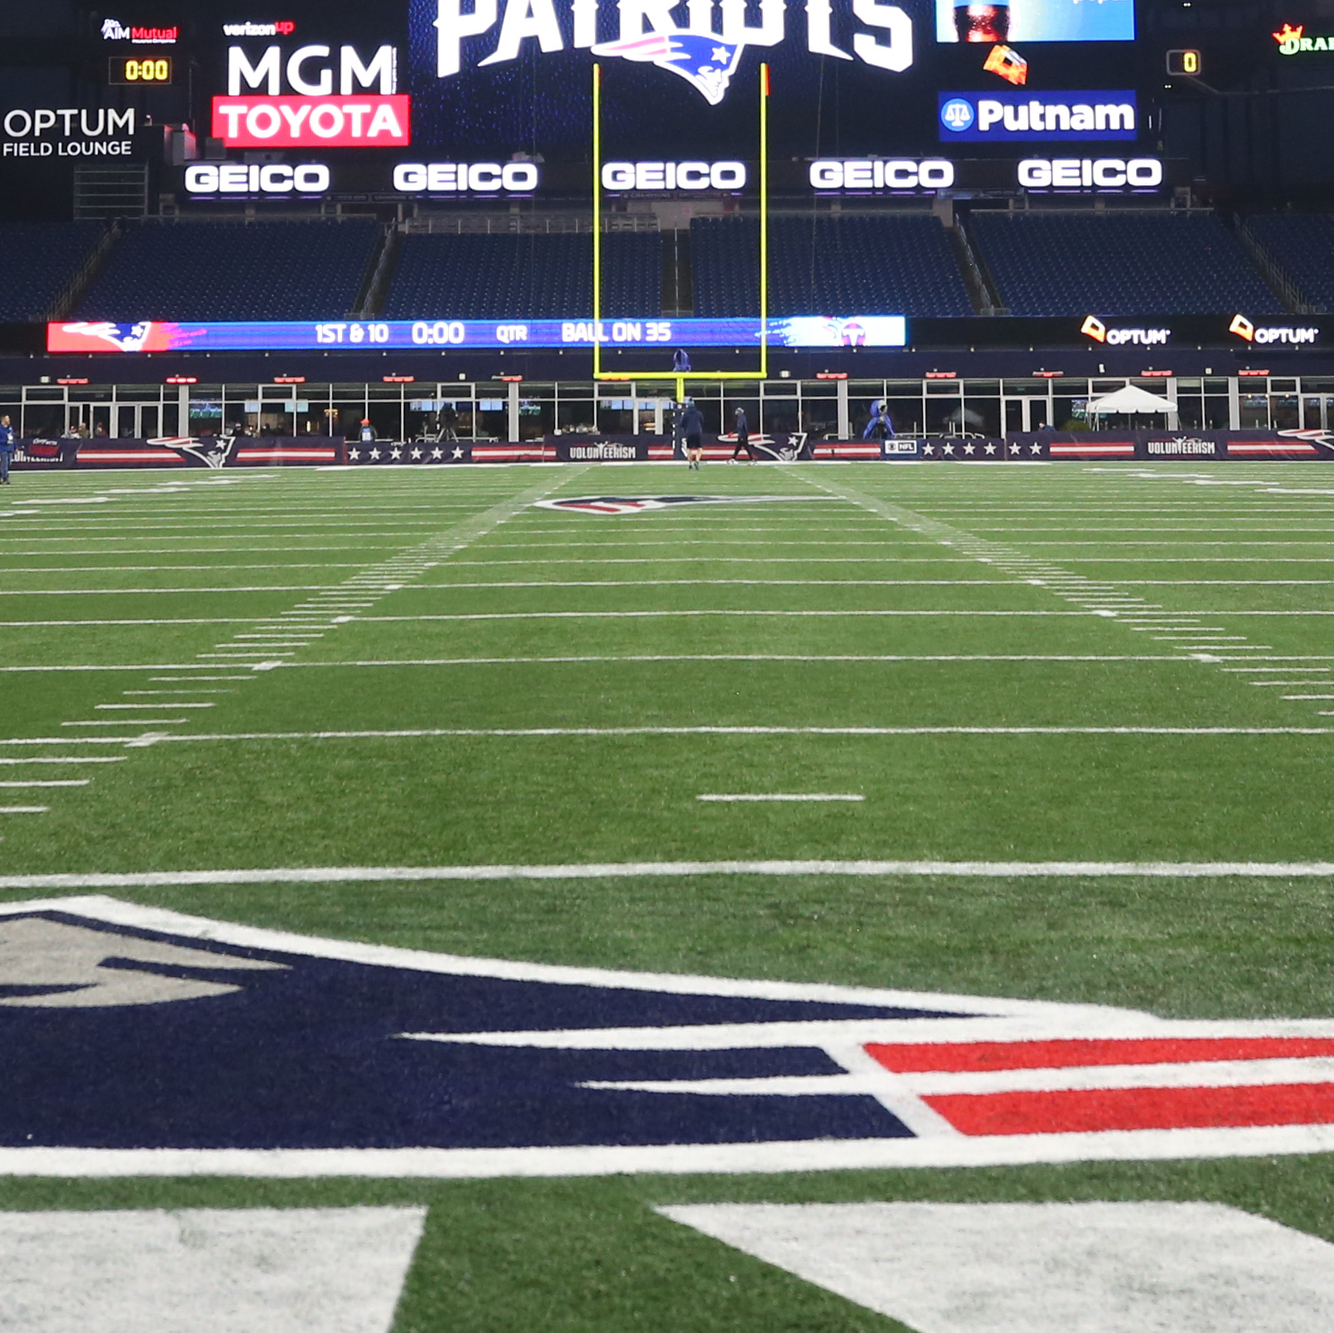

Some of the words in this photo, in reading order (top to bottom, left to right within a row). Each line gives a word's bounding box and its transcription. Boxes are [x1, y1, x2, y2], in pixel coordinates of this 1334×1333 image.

[131, 26, 178, 40] Mutual
[125, 60, 168, 81] 0:00
[228, 45, 393, 96] MGM
[3, 108, 135, 137] OPTUM
[219, 104, 402, 138] TOYOTA
[978, 99, 1135, 131] Putnam
[3, 142, 53, 157] FIELD
[58, 141, 132, 156] LOUNGE
[185, 165, 329, 193] GEICO
[393, 163, 538, 191] GEICO
[601, 161, 746, 190] GEICO
[810, 160, 954, 189] GEICO
[1018, 158, 1162, 187] GEICO
[315, 324, 345, 342] 1ST
[349, 324, 364, 342] &
[364, 324, 389, 342] 10
[412, 322, 464, 343] 0:00
[497, 325, 527, 341] QTR
[562, 323, 608, 342] BALL
[613, 323, 642, 341] ON
[646, 322, 671, 341] 35
[1106, 329, 1166, 345] OPTUM
[1255, 327, 1314, 344] OPTUM
